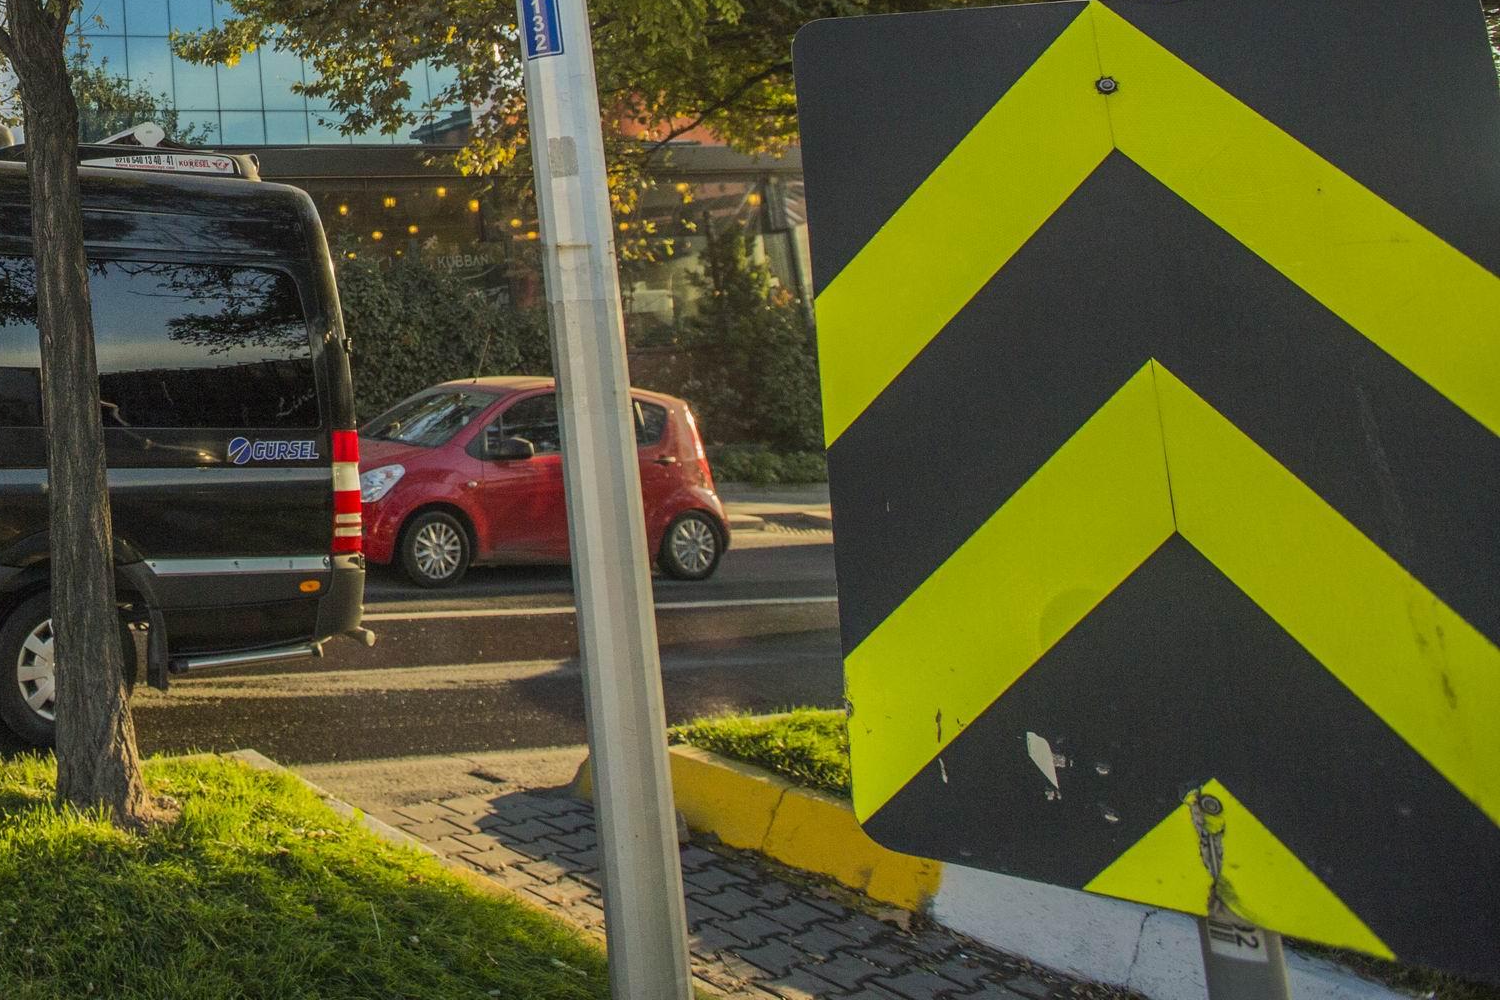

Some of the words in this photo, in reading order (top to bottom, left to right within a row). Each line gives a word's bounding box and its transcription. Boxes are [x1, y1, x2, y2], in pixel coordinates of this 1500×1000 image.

[145, 156, 153, 165] 13
[166, 155, 174, 166] 41
[253, 440, 320, 461] GÜRSEL
